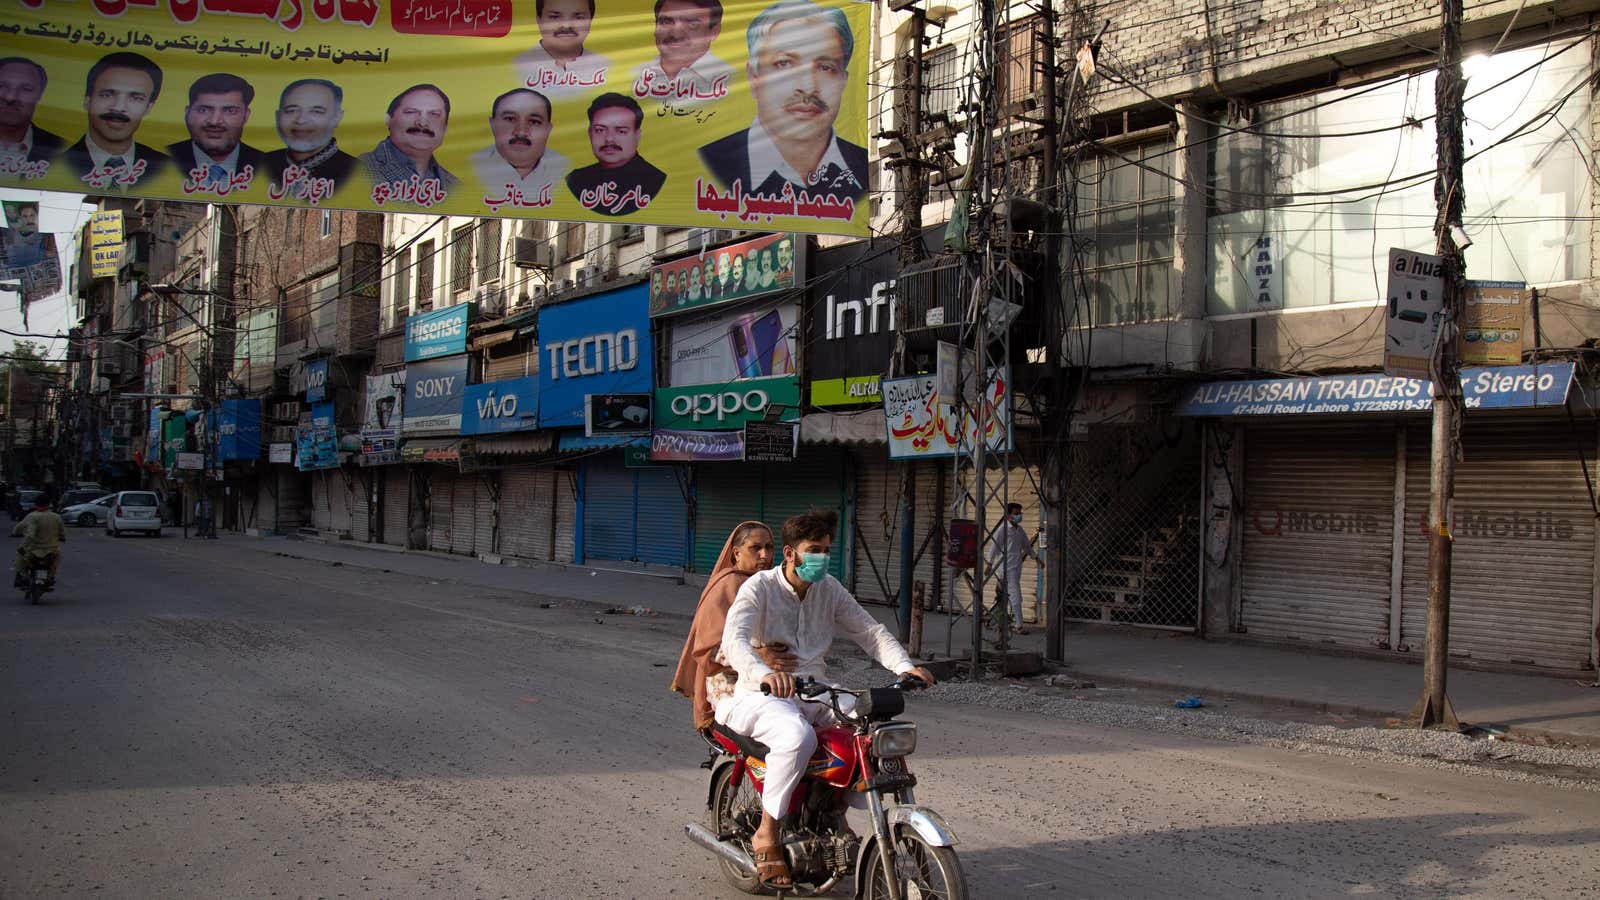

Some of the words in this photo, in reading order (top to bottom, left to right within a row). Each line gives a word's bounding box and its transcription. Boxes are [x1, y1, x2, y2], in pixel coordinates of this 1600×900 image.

[413, 4, 449, 28] اسلام
[449, 0, 474, 32] عالم
[474, 5, 501, 31] تمام
[270, 43, 331, 61] تاجران
[332, 48, 390, 65] انجمن
[526, 67, 557, 88] اقبال
[558, 70, 577, 87] خالد
[581, 66, 607, 87] ملک
[632, 69, 654, 97] علی
[652, 79, 695, 99] امانت
[695, 72, 729, 99] ملک
[81, 165, 125, 187] سعید
[117, 159, 148, 184] محمد
[183, 163, 217, 194] رفیق
[217, 164, 254, 196] فیصل
[268, 164, 307, 200] مغل
[299, 176, 335, 205] اعجاز
[391, 175, 418, 200] نواز
[416, 177, 446, 207] حاجی
[483, 184, 523, 212] ثاقب
[522, 182, 552, 208] ملک
[579, 181, 617, 209] خان
[610, 184, 651, 215] عامر
[738, 180, 797, 223] شبیر
[795, 190, 856, 222] محمد
[1255, 236, 1273, 303] HAMZA
[409, 316, 461, 344] Hisense
[546, 328, 639, 380] TECNO
[415, 376, 455, 399] SONY
[1190, 381, 1312, 404] ALI-HASSAN
[1316, 376, 1422, 401] TRADERS
[1474, 370, 1554, 394] Stereo
[477, 389, 519, 420] vivo
[1231, 403, 1272, 415] 47-Hall
[1273, 403, 1304, 415] Road
[1306, 401, 1350, 414] Lahore
